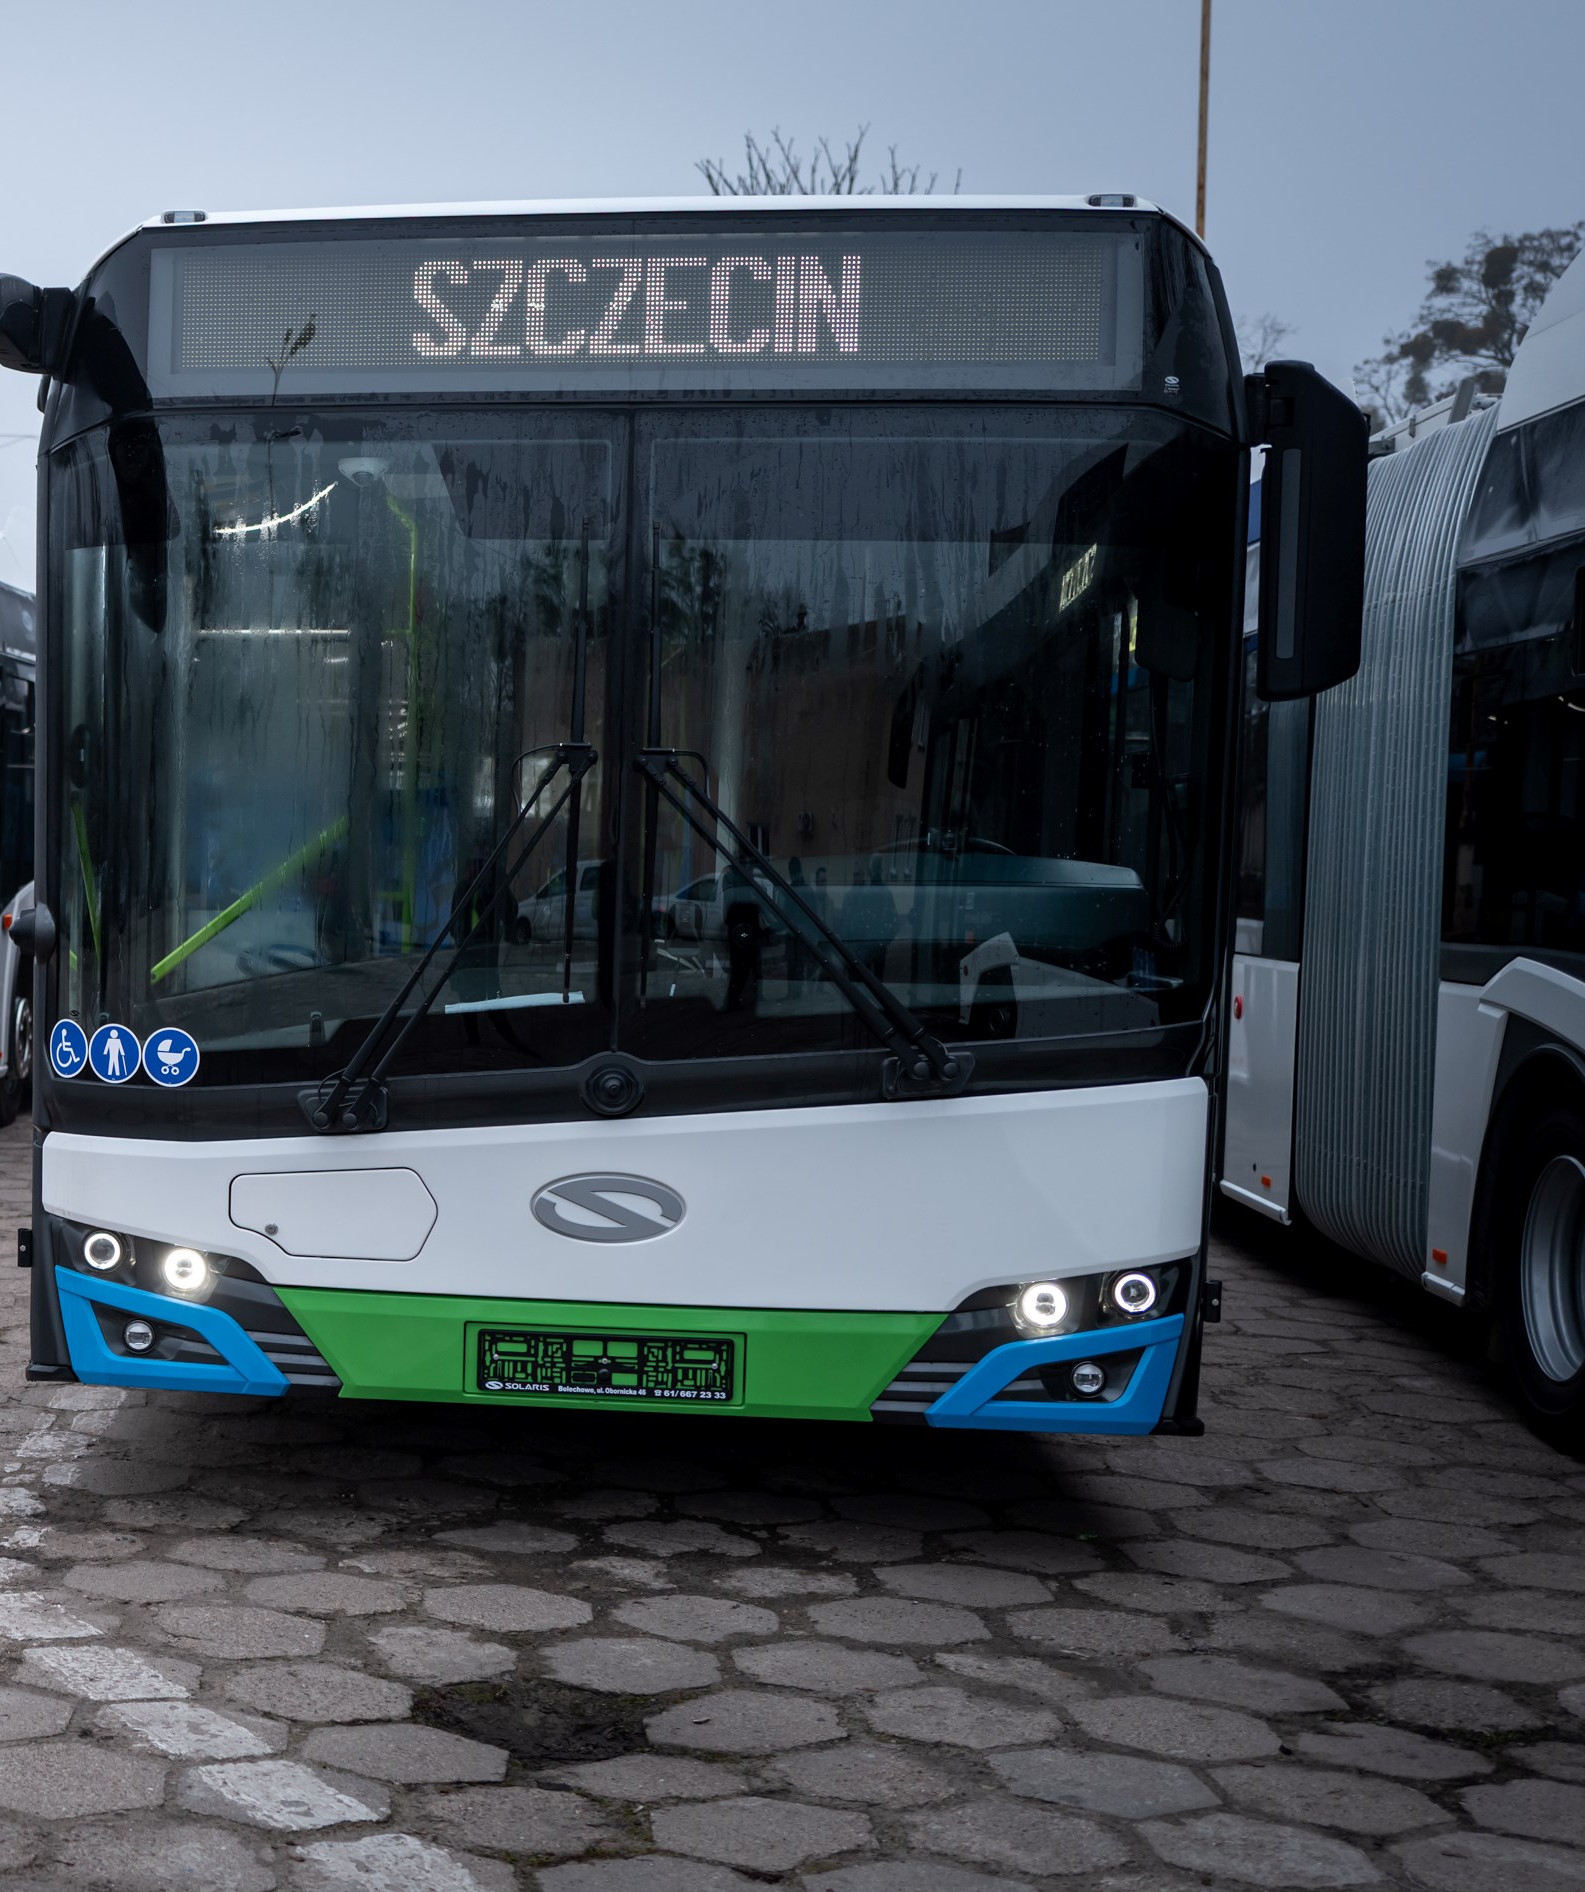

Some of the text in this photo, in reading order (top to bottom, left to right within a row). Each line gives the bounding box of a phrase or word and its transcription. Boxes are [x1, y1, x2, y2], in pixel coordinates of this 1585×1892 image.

[413, 256, 861, 355] SZCZECIN
[504, 1382, 550, 1392] SOLARIS
[558, 1385, 596, 1395] Bolechowo,
[605, 1387, 637, 1395] Obornicka
[699, 1391, 712, 1399] 23
[714, 1391, 727, 1399] 33
